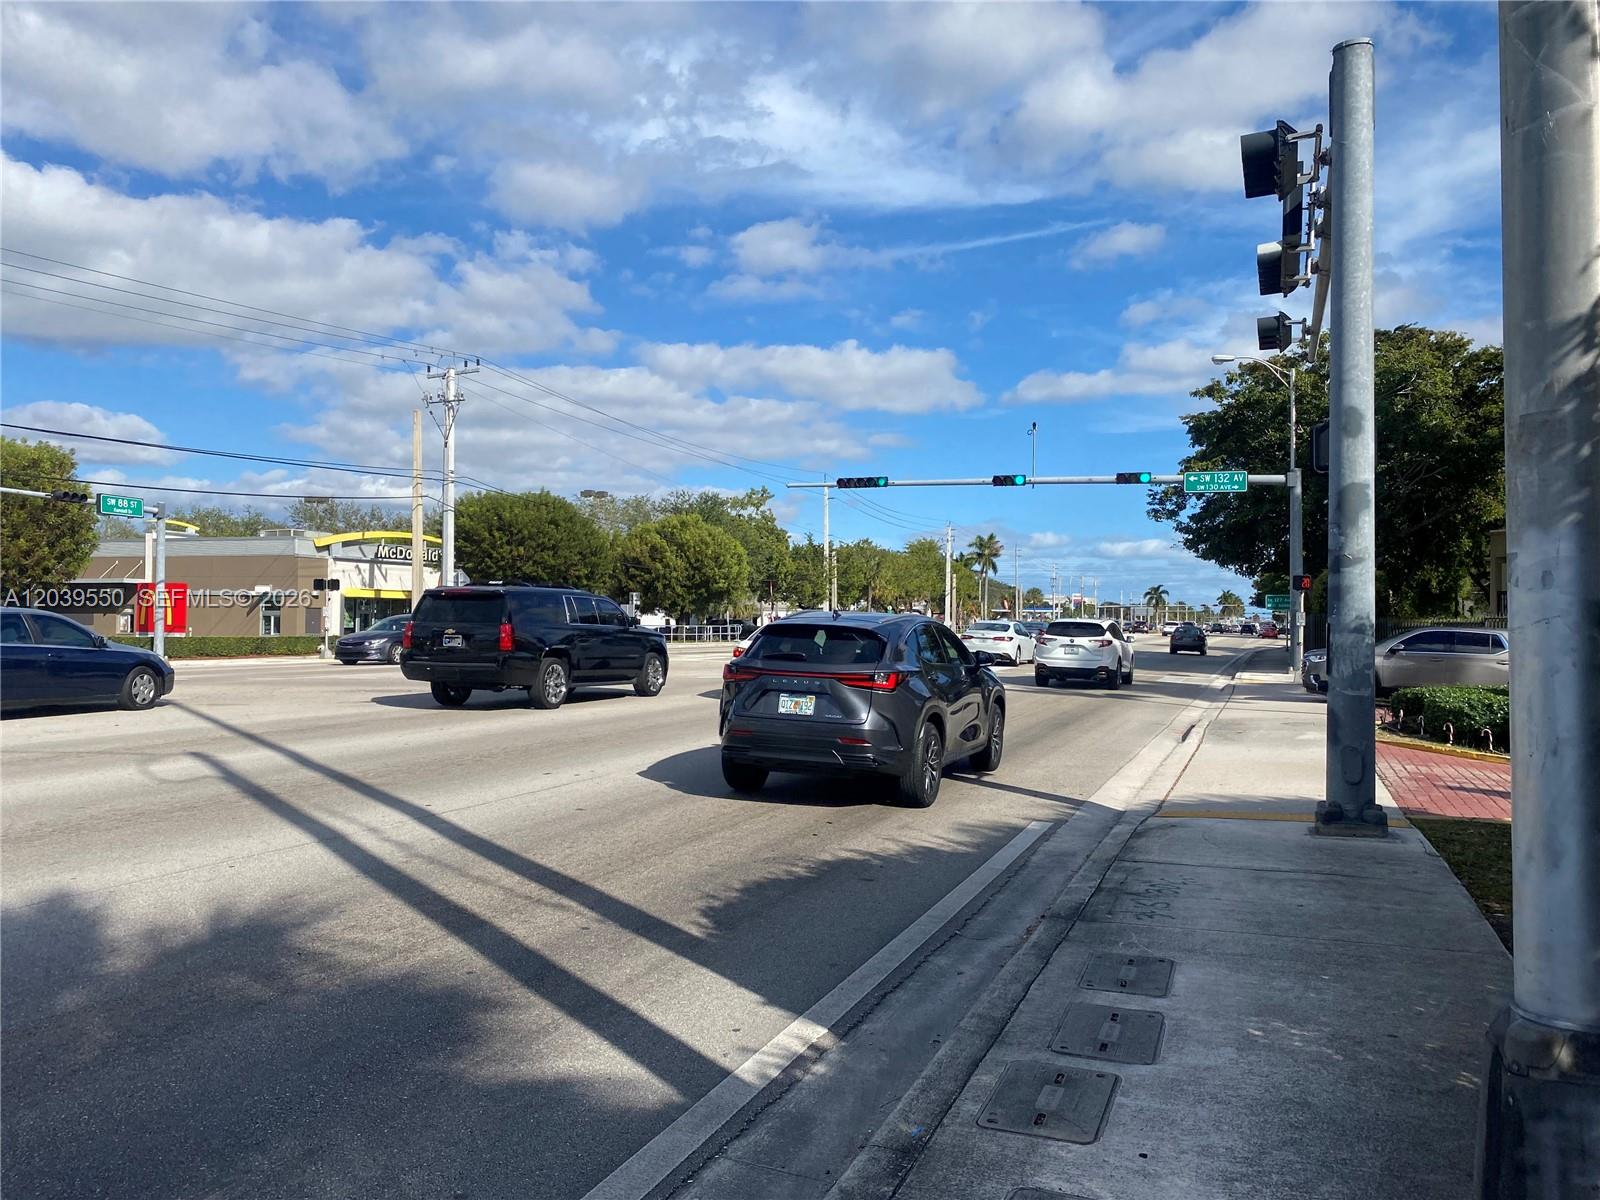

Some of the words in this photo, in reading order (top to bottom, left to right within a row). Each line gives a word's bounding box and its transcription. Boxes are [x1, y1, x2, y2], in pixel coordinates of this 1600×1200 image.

[1200, 474, 1210, 483] SW
[1214, 473, 1230, 483] 132
[1233, 473, 1244, 482] AV
[106, 498, 116, 506] SW
[117, 499, 128, 508] 88
[378, 545, 442, 561] McDoald'
